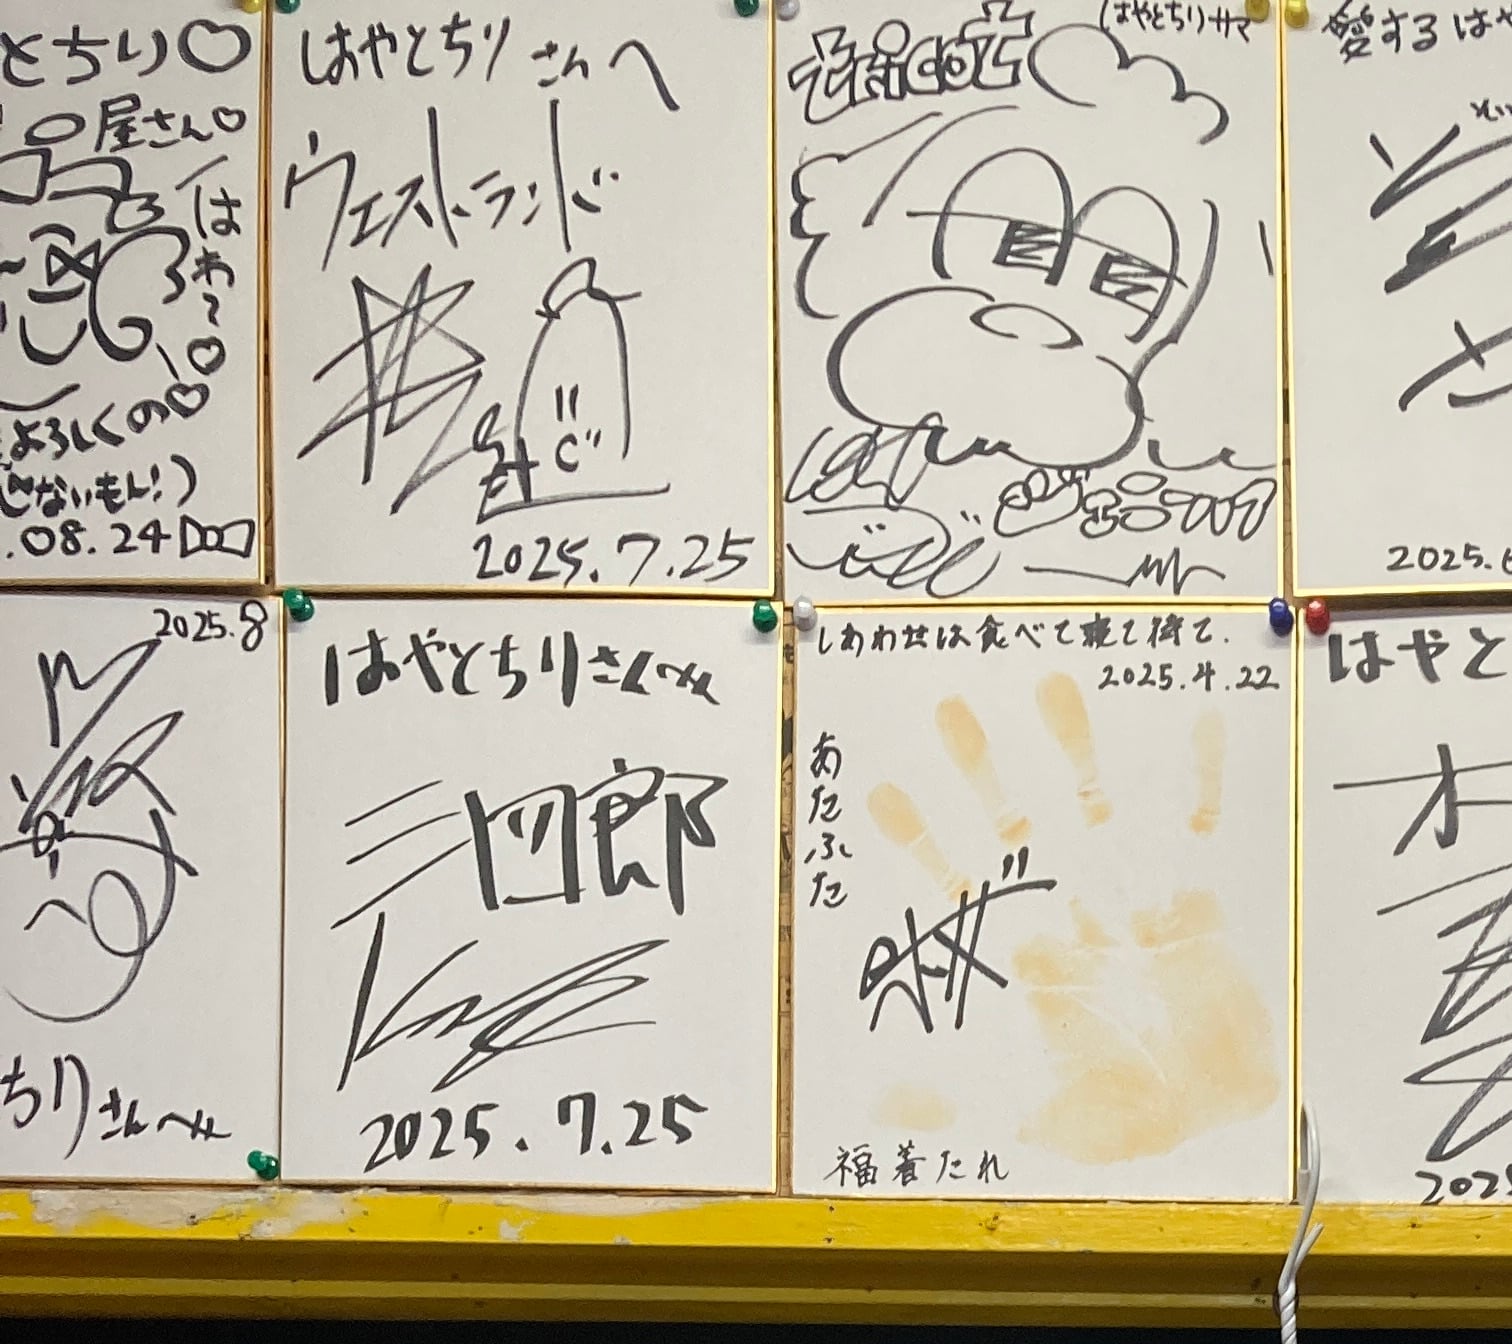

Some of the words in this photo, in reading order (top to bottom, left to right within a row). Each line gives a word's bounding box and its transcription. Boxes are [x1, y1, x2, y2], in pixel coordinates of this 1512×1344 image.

[152, 600, 269, 652] 2025.8
[1098, 661, 1281, 692] 2025.4.22
[804, 731, 853, 908] あたふた
